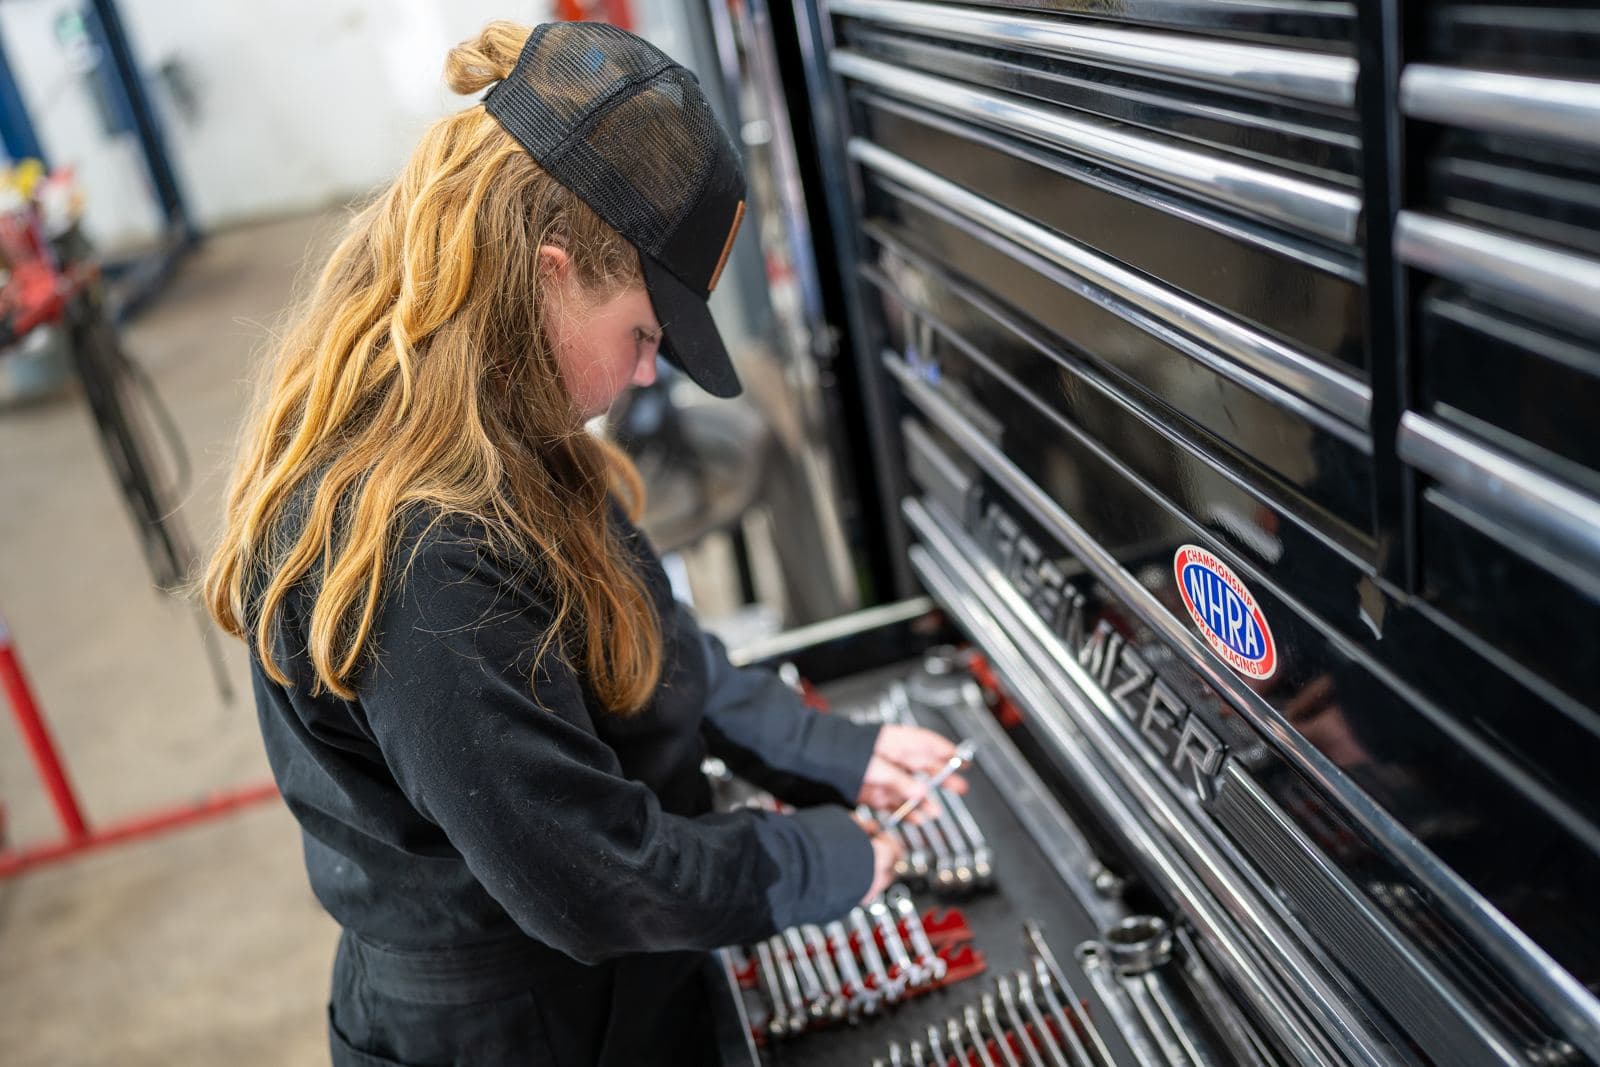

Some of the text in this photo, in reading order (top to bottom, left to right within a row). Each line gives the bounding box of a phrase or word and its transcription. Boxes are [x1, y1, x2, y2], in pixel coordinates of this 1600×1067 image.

[1187, 549, 1253, 607] CHAMPIONSHIP
[1189, 567, 1259, 656] NHRA
[1193, 612, 1257, 674] DRAG RACING
